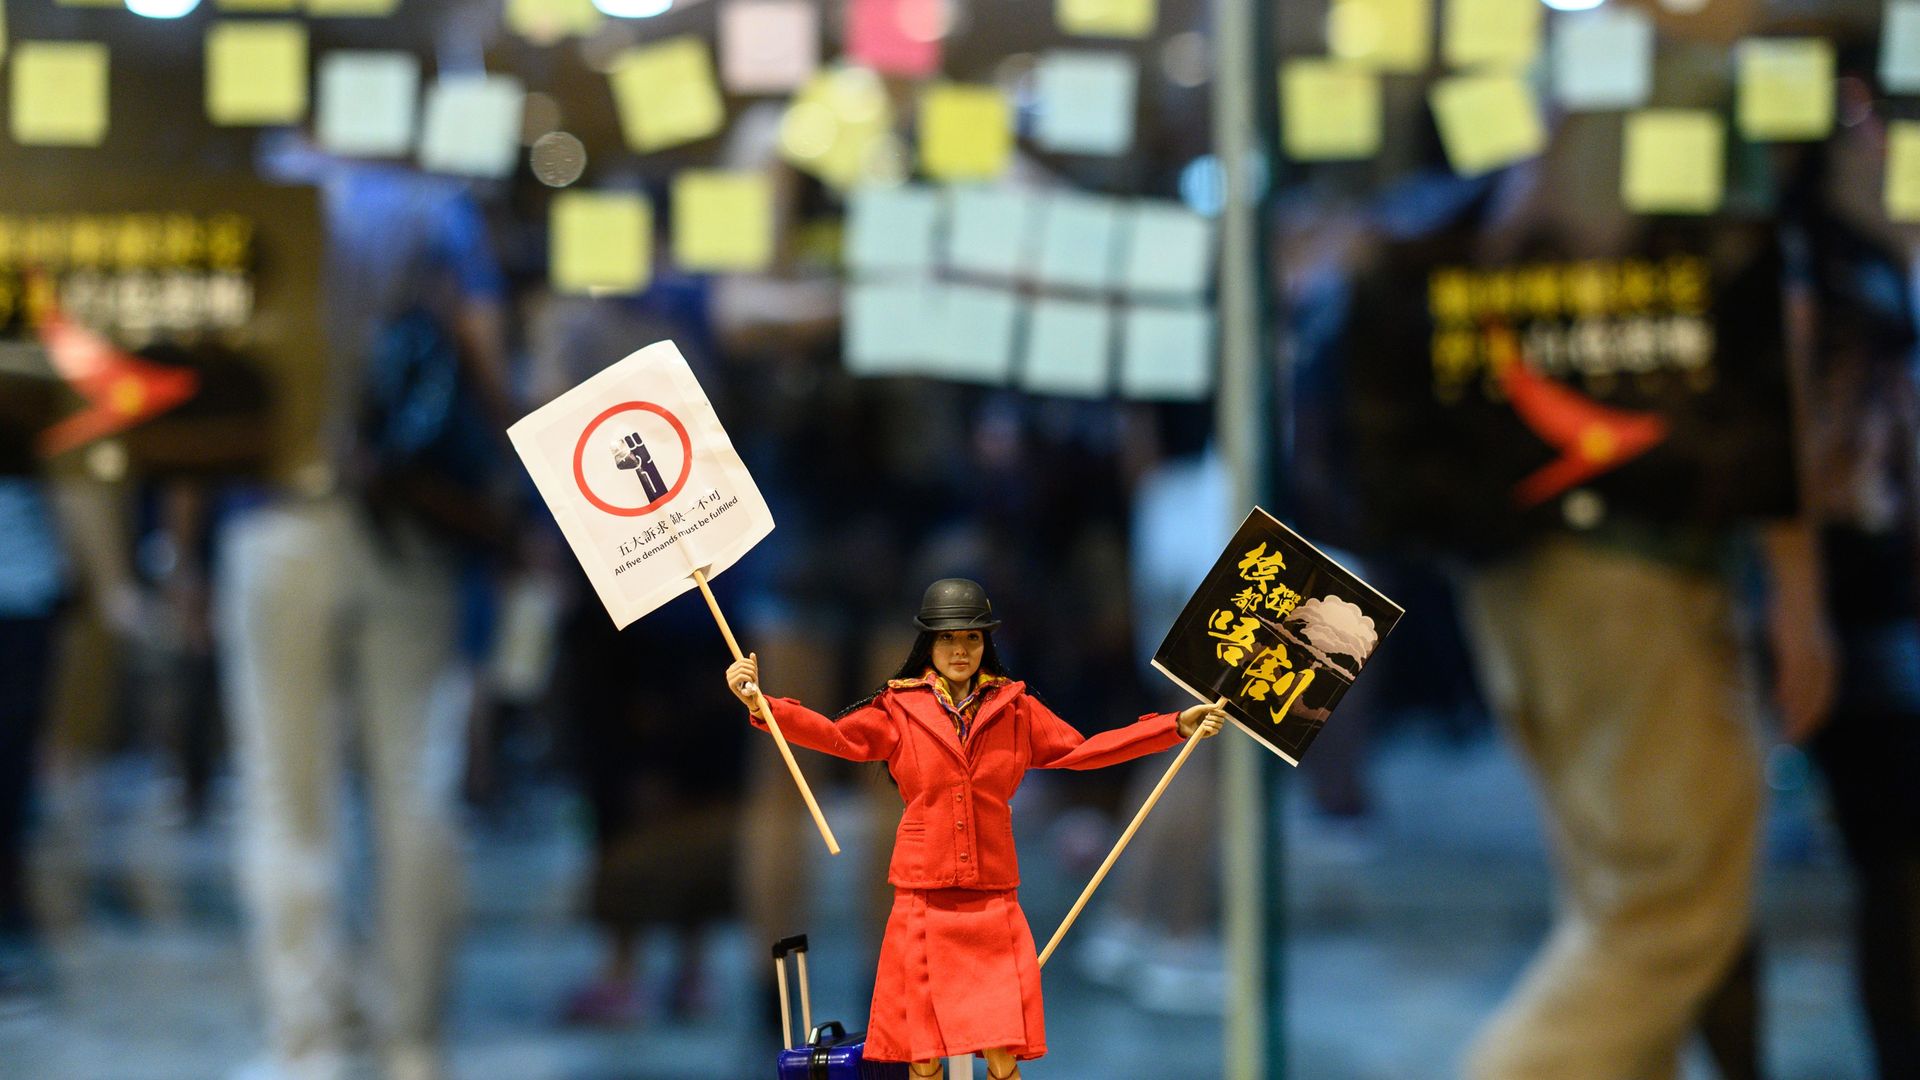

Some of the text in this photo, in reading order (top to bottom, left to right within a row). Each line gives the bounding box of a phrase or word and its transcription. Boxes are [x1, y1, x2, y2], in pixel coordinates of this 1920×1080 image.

[614, 495, 738, 576] All five demands must be fulfilled
[616, 520, 669, 557] 五大訴求
